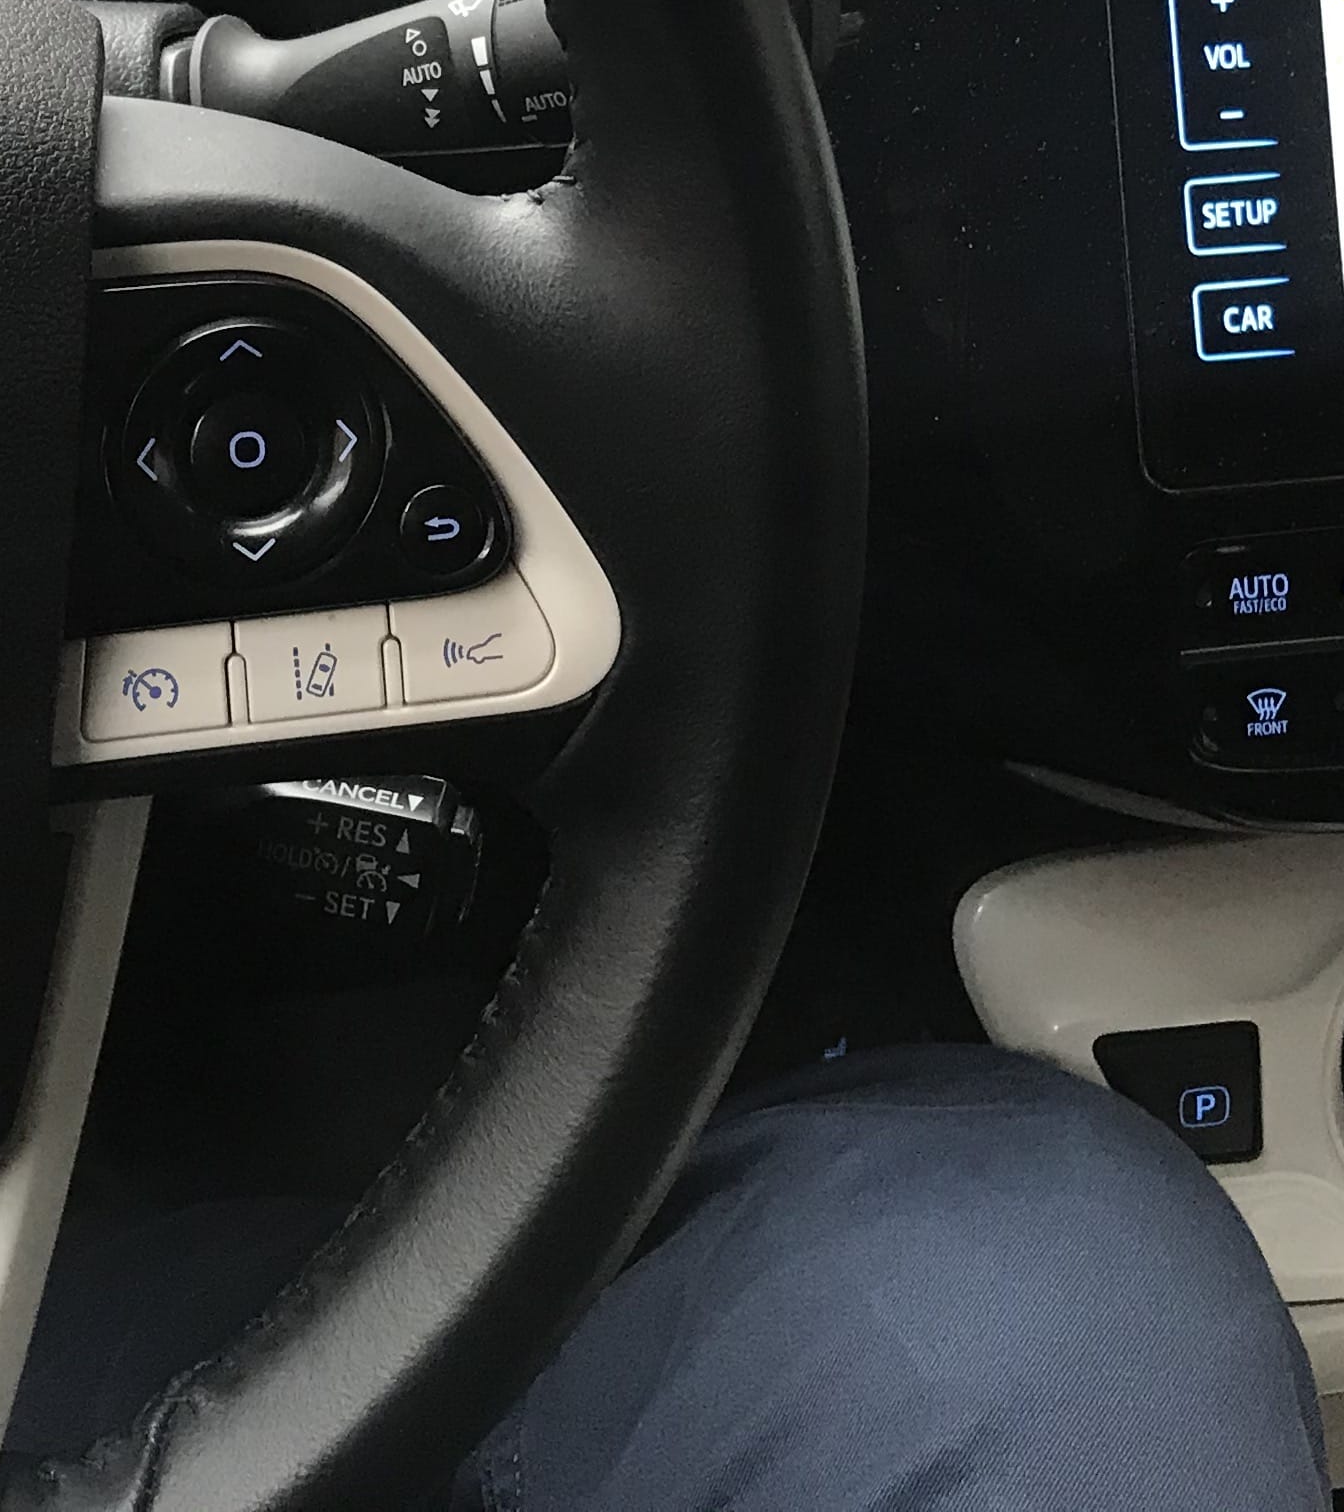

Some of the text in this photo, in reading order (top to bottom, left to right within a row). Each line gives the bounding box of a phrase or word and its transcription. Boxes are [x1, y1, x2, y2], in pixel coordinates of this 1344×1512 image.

[1203, 43, 1251, 71] VOL
[402, 61, 442, 87] AUTO
[524, 91, 567, 112] AUTO
[1202, 197, 1278, 229] SETUP
[1223, 304, 1274, 334] CAR
[1229, 573, 1289, 601] AUTO
[1232, 596, 1288, 615] FAST/ECO
[1247, 719, 1289, 736] FRONT
[302, 779, 405, 810] CANCEL
[336, 815, 387, 847] RES
[324, 891, 376, 921] SET
[1196, 1094, 1216, 1121] P
